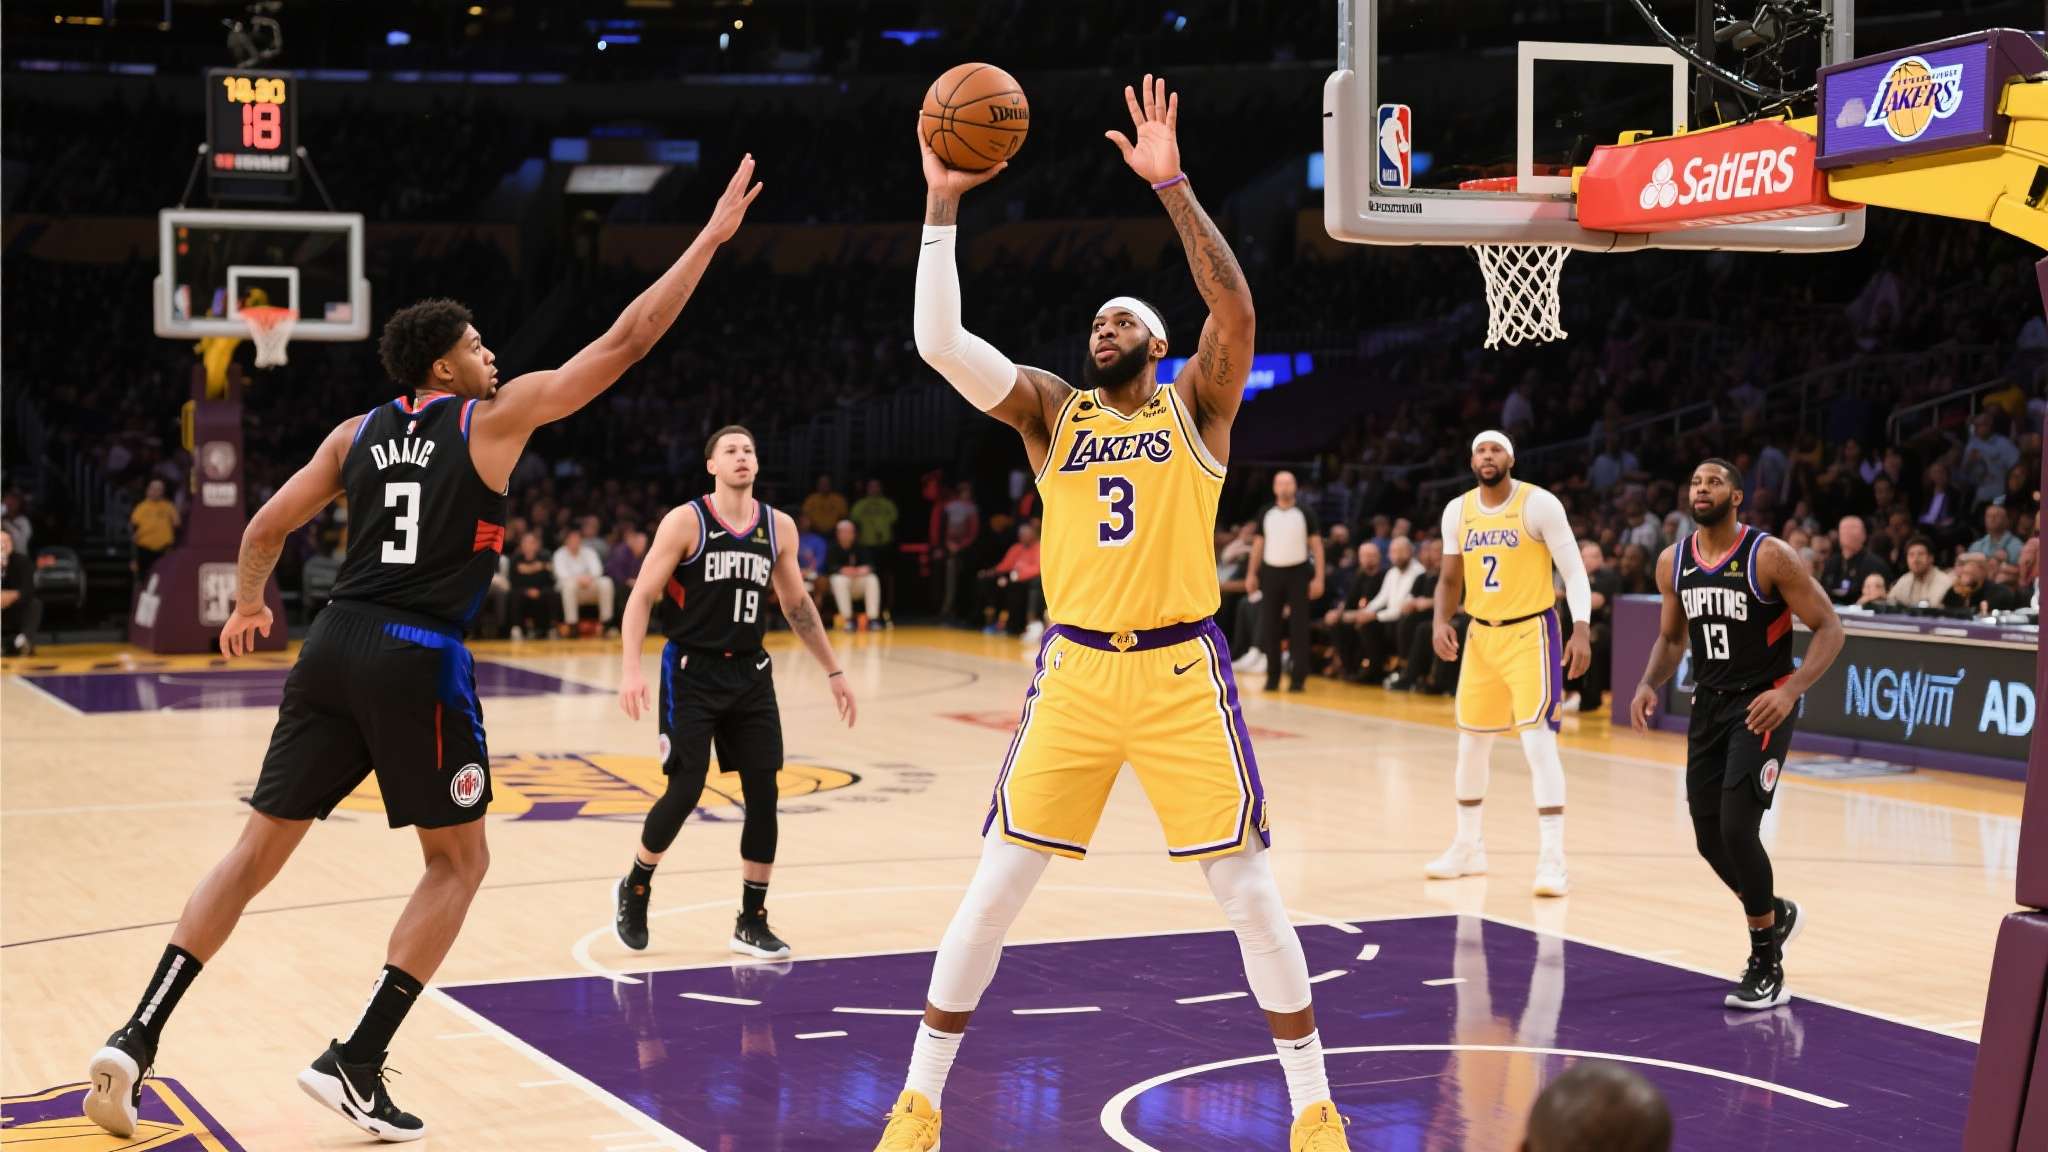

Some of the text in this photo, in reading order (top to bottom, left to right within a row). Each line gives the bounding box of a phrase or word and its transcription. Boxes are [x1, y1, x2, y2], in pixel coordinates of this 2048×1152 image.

[1868, 80, 1956, 121] LAKERS
[242, 103, 281, 150] 18
[1059, 429, 1172, 472] LAKERS
[381, 481, 421, 564] 3
[1098, 475, 1136, 545] 3
[1464, 528, 1519, 552] LAKERS
[1482, 555, 1500, 588] 2
[733, 588, 759, 624] 19
[1702, 623, 1730, 660] 13
